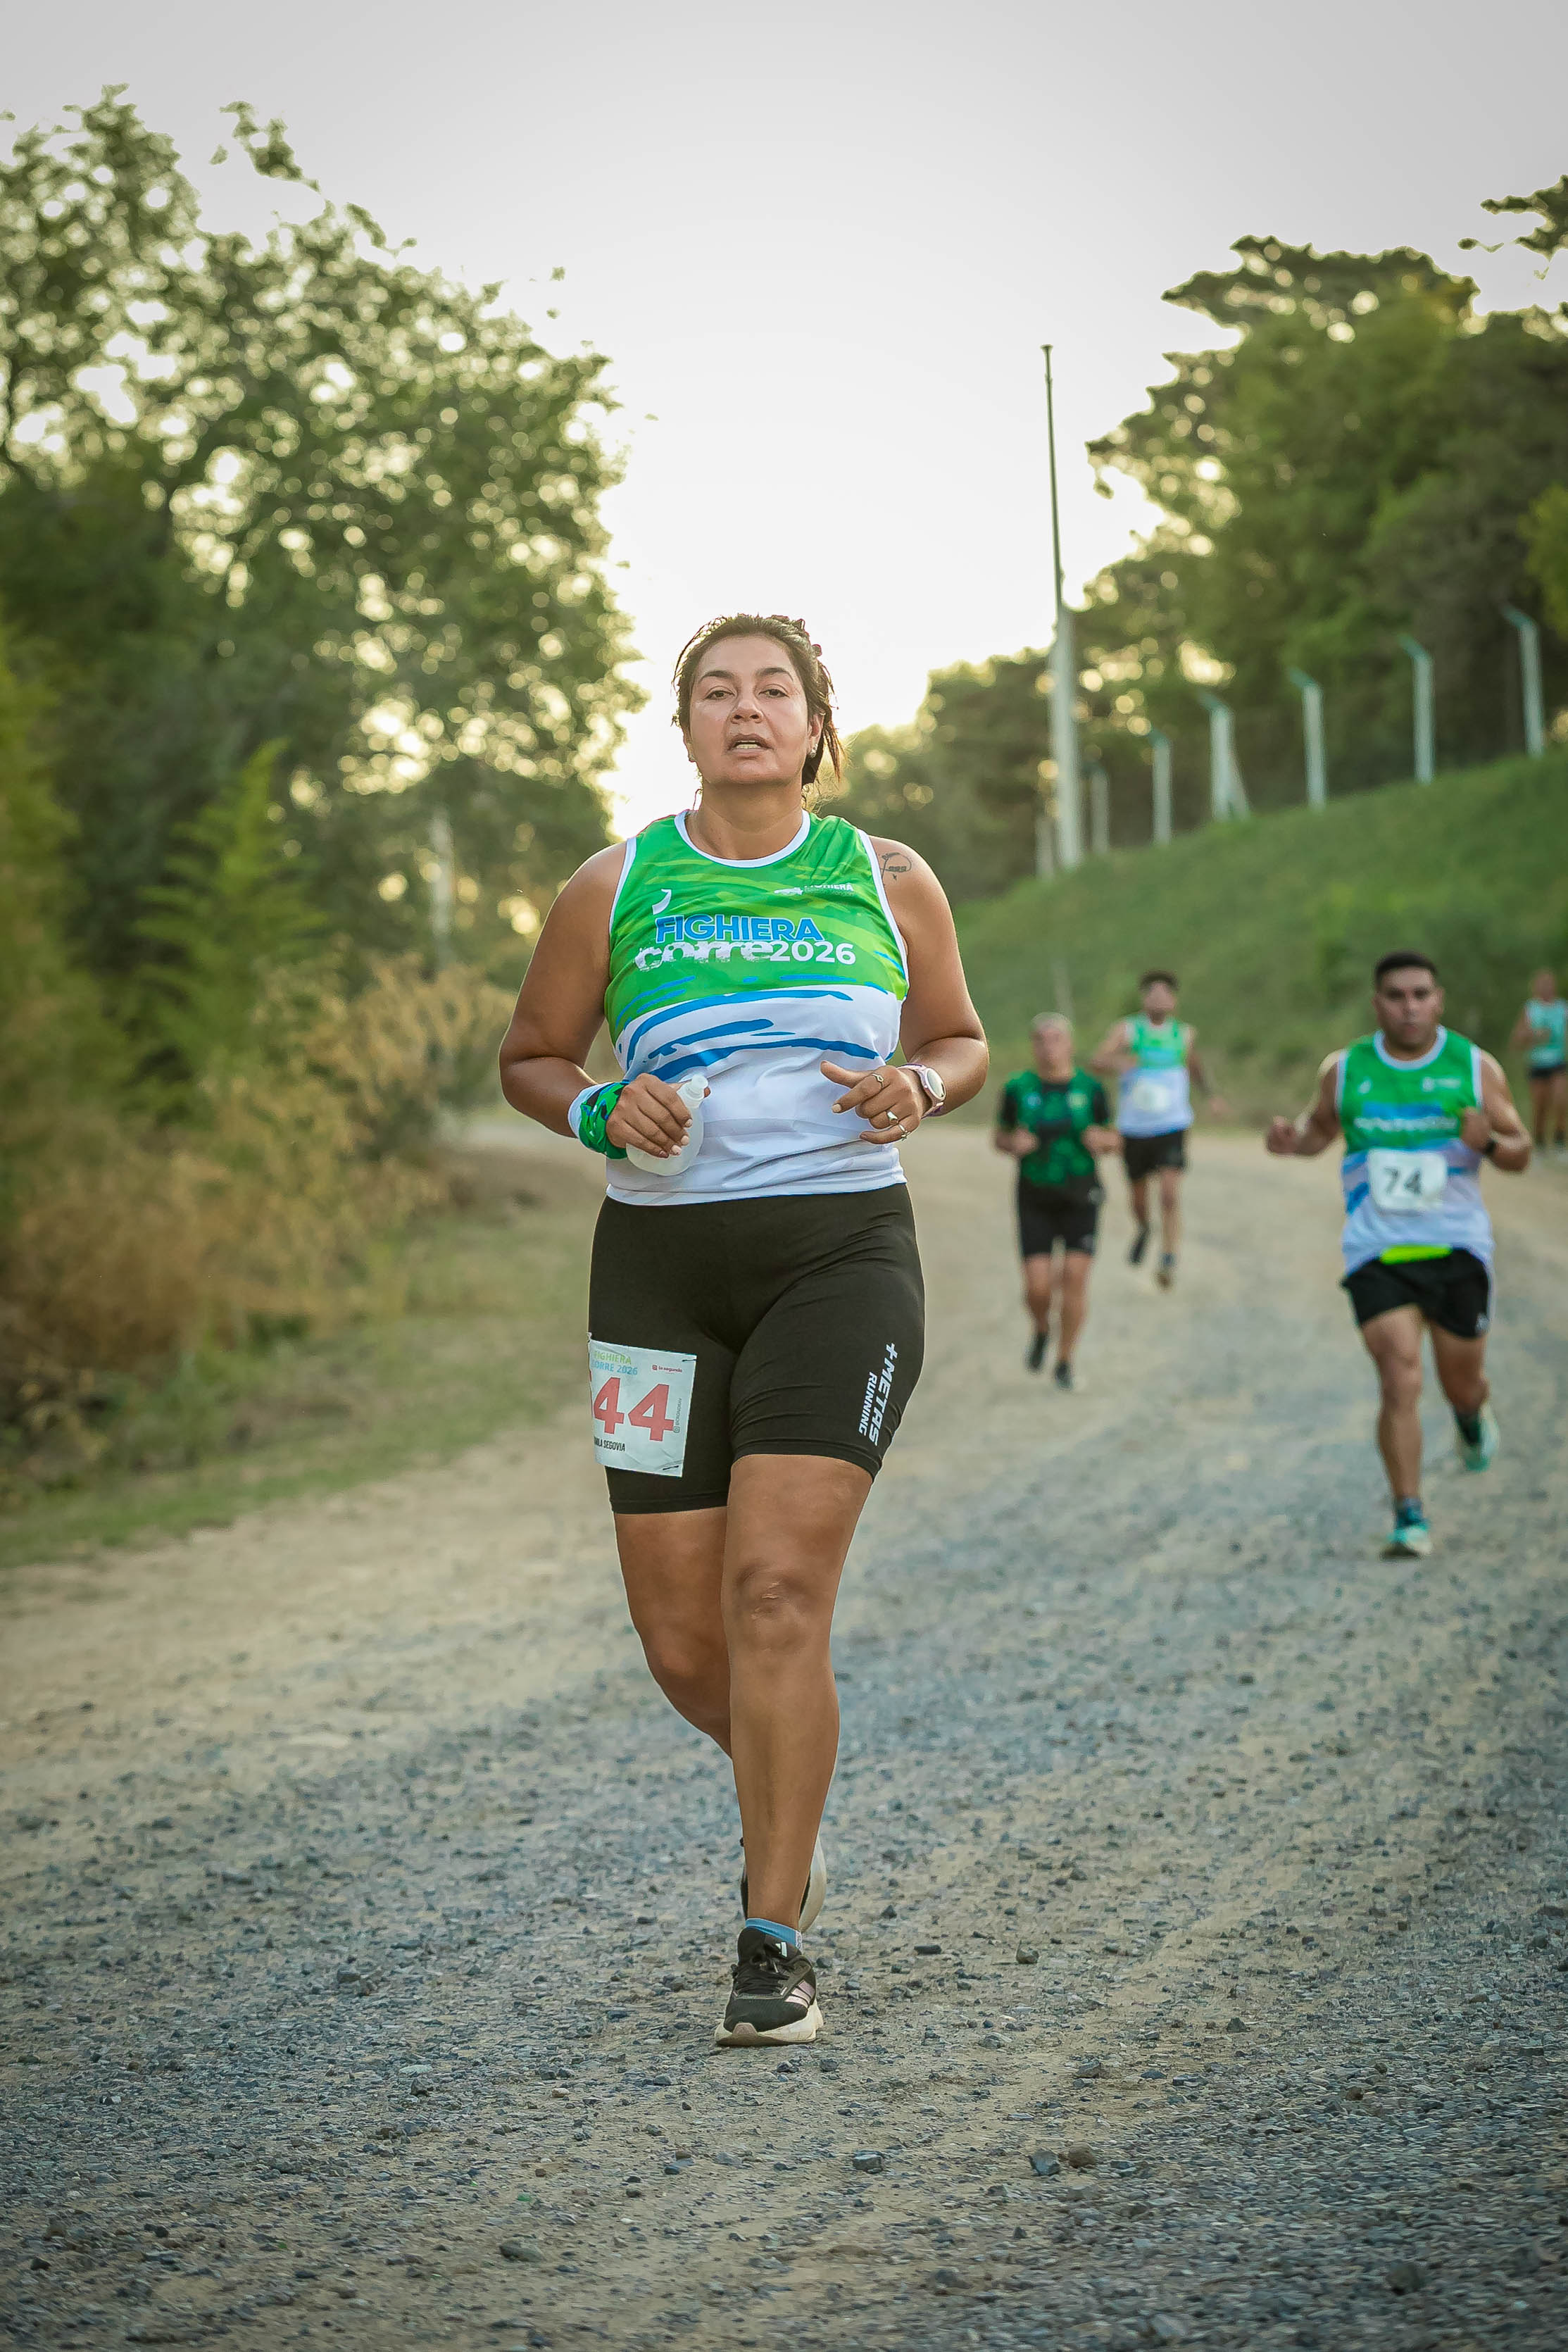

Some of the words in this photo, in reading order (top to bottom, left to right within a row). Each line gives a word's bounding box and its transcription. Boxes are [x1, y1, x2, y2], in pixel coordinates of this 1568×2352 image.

[655, 914, 824, 944] FIGHIERA
[1384, 1165, 1422, 1195] 74
[617, 1365, 638, 1375] 2026
[589, 1370, 675, 1441] 44
[858, 1372, 878, 1437] RUNNING
[603, 1439, 625, 1452] SEGOVIA
